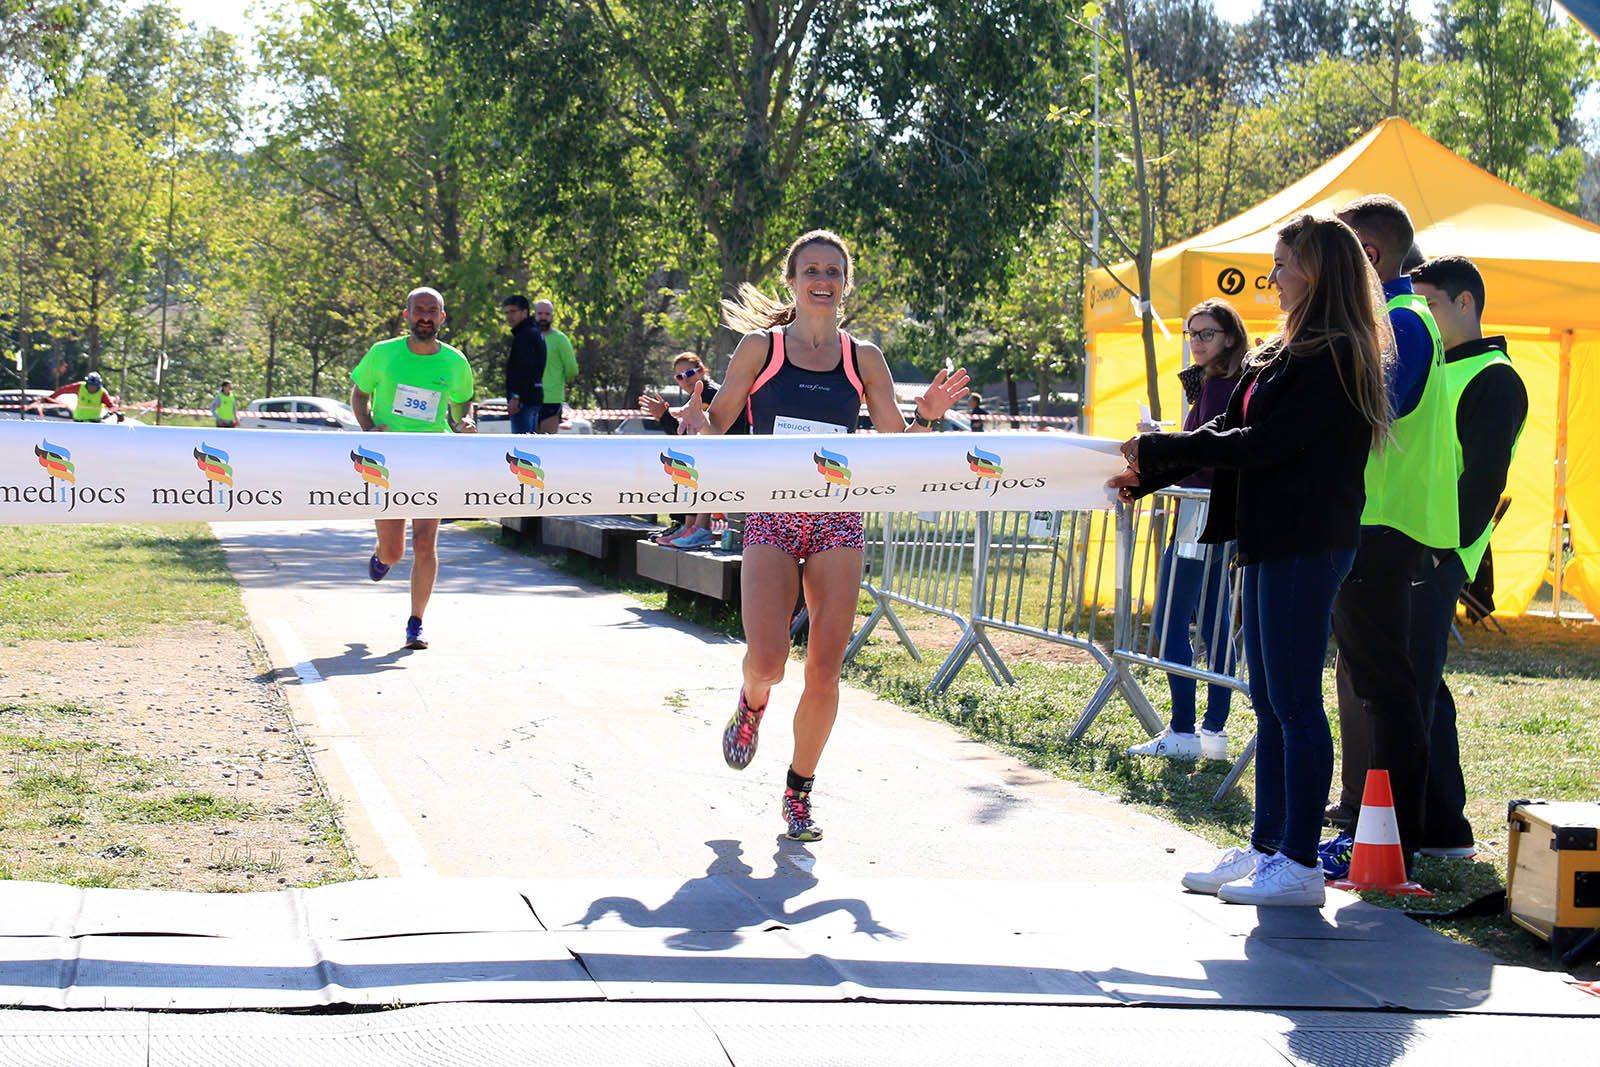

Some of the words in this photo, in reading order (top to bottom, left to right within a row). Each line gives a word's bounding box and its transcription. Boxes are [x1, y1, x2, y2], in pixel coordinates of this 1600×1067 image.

[404, 397, 428, 411] 398
[777, 421, 812, 433] MEDIJOCS
[0, 475, 126, 512] medijocs
[152, 479, 282, 513] medijocs
[309, 482, 438, 512] medijocs
[464, 483, 593, 512] medijocs
[618, 483, 745, 509] medijocs
[771, 482, 896, 504] medijocs
[921, 477, 1047, 497] medijocs
